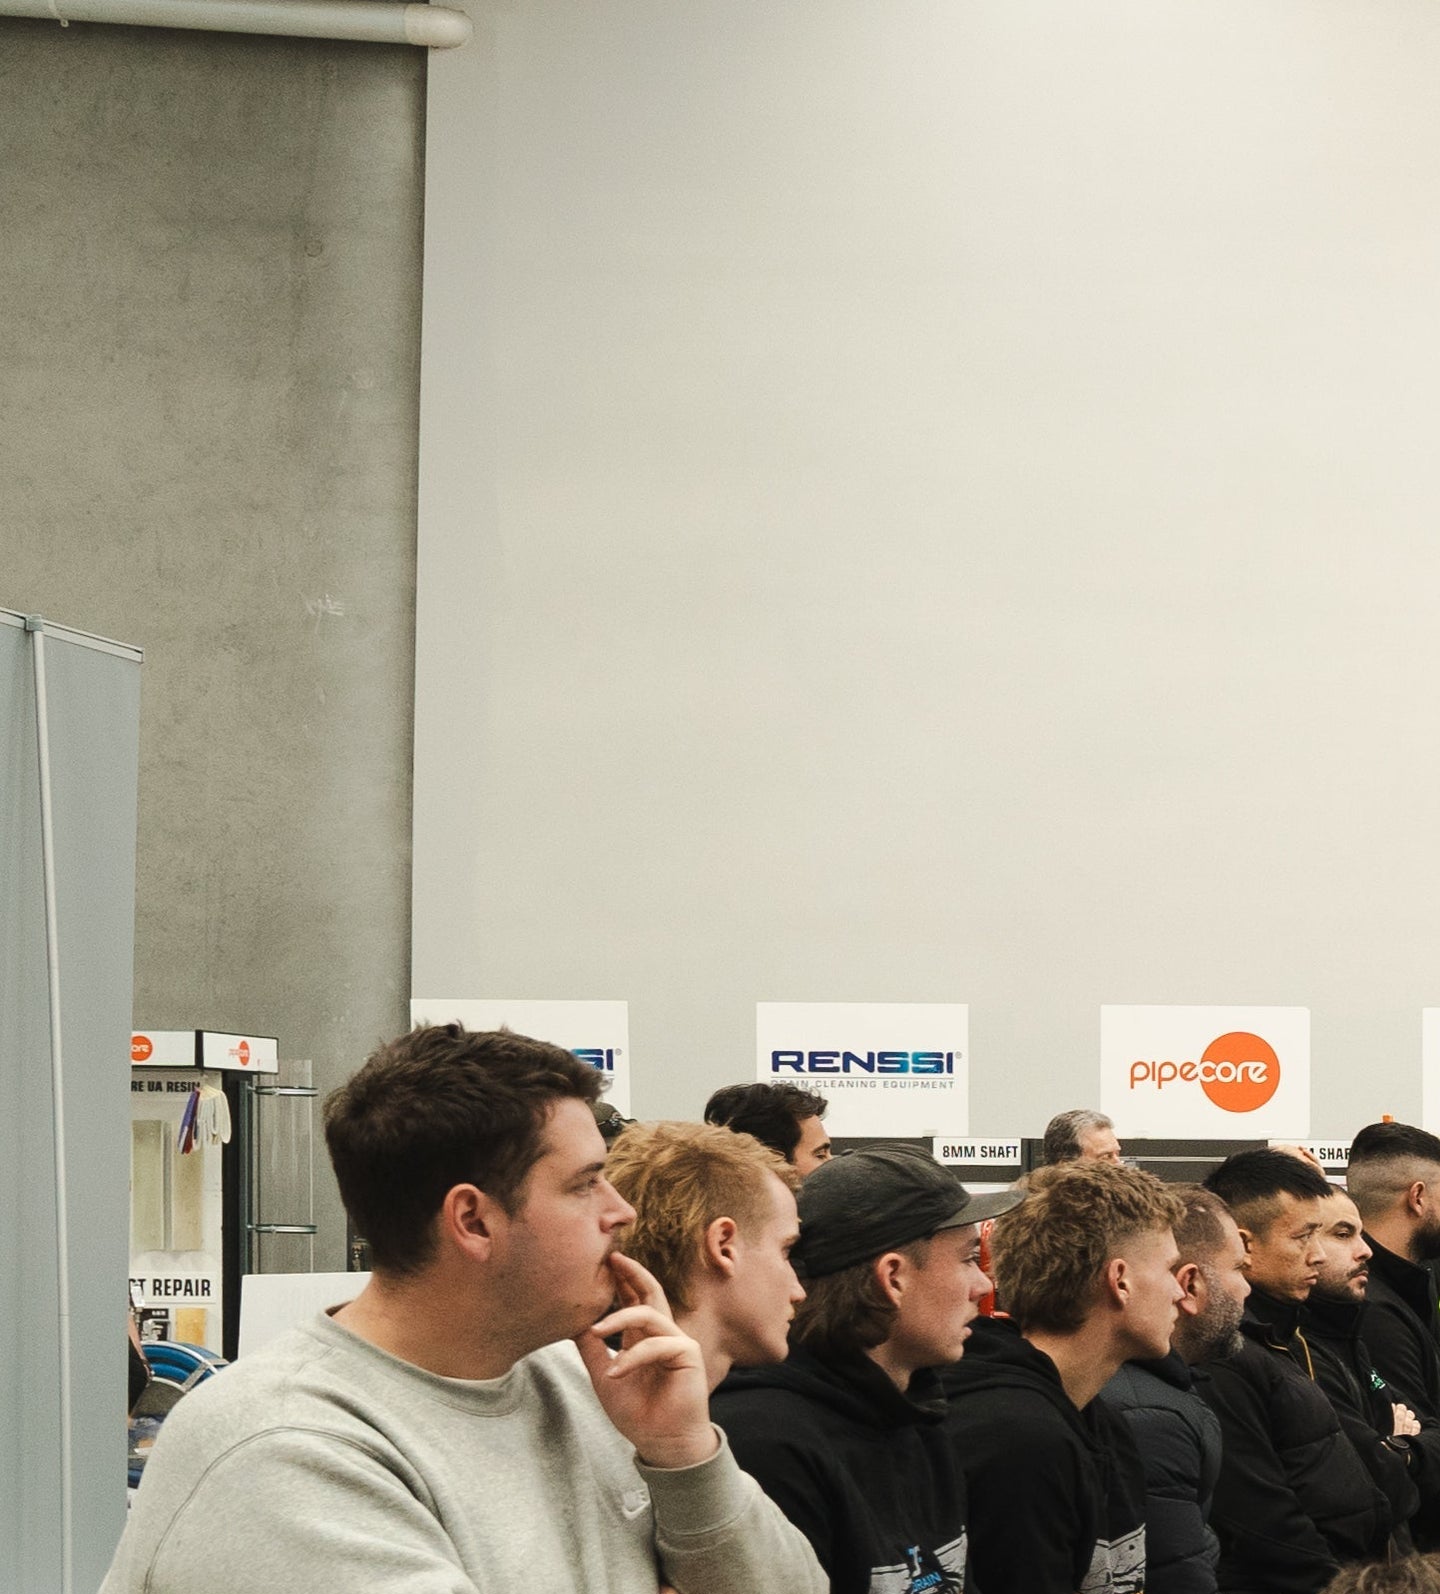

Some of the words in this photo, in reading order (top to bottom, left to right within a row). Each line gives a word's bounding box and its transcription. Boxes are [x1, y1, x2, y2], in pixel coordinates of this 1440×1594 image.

[771, 1050, 954, 1075] RENSSI
[1130, 1060, 1268, 1089] pipecore
[815, 1080, 878, 1089] CLEANING
[883, 1080, 955, 1090] EQUIPMENT
[942, 1145, 976, 1159] 8MM
[980, 1145, 1019, 1159] SHAFT
[1319, 1147, 1351, 1160] SHAF
